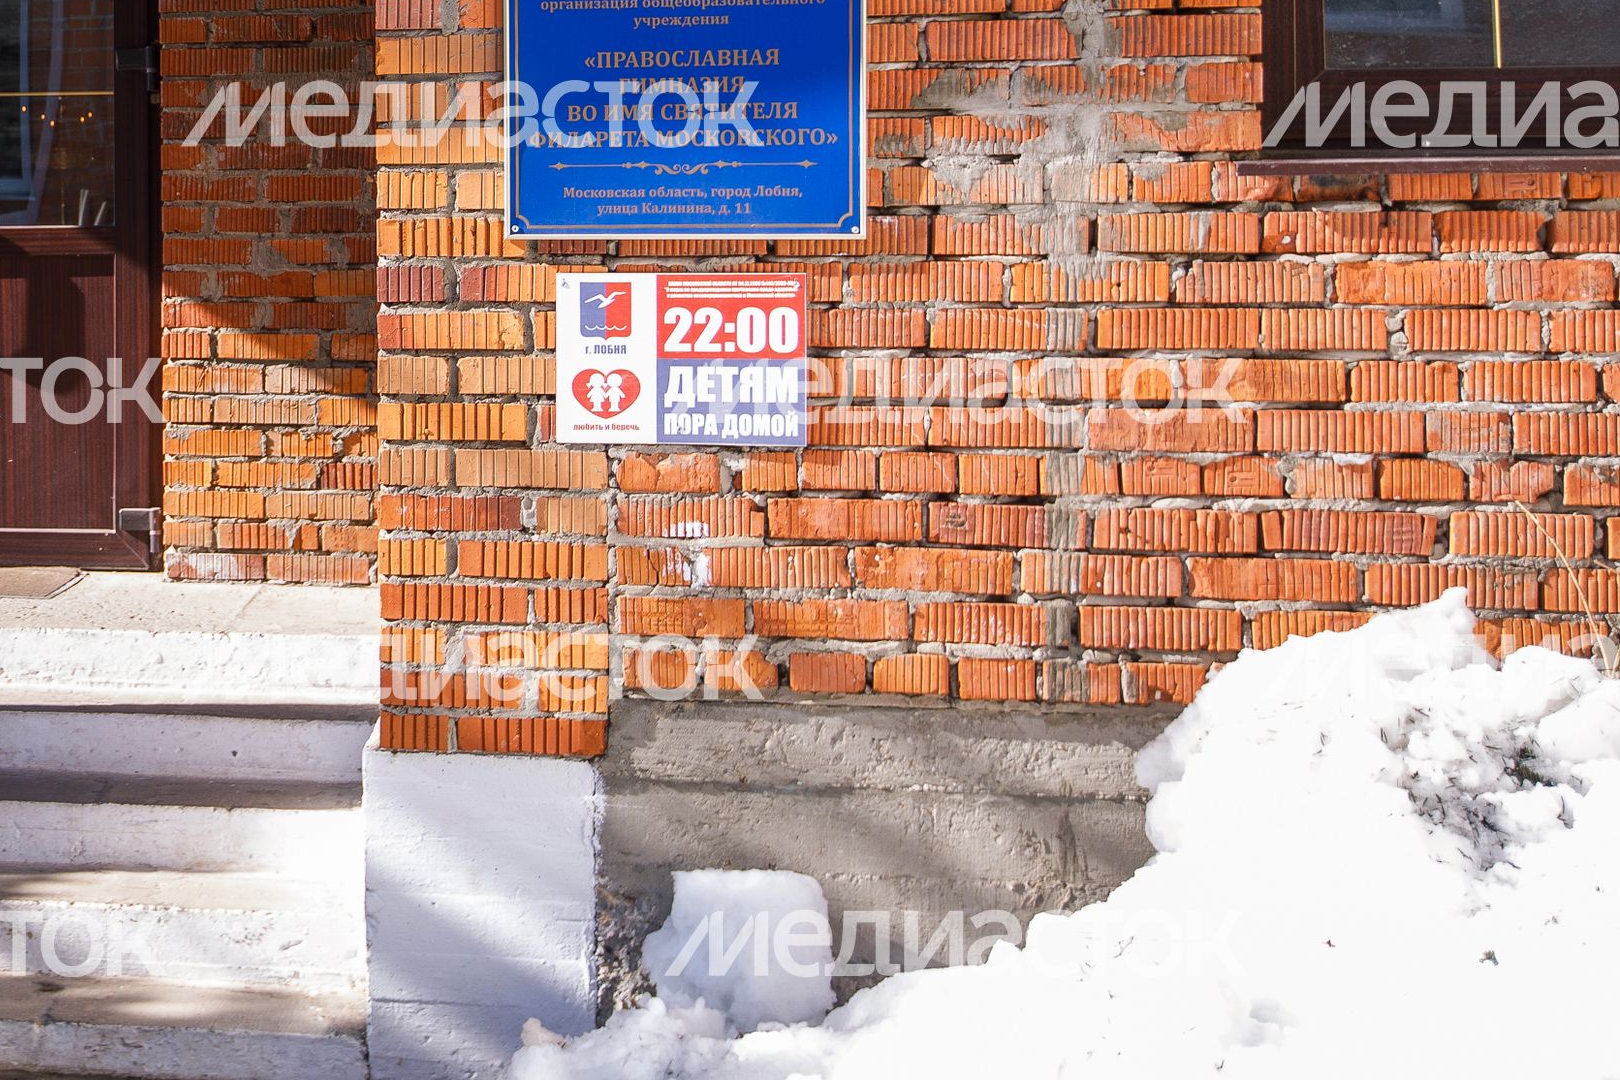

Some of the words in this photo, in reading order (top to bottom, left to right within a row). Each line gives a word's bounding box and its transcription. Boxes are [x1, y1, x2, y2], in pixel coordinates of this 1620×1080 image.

[540, 0, 638, 13] организация
[633, 15, 729, 29] учреждения
[584, 48, 779, 69] «ПРАВОСЛАВНАЯ
[619, 76, 745, 95] ГИМНАЗИЯ
[567, 104, 597, 122] ВО
[604, 103, 654, 121] ИМЯ
[661, 101, 798, 121] СВЯТИТЕЛЯ
[531, 130, 650, 149] ФИЛАРЕТА
[655, 127, 837, 148] МОСКОВСКОГО»
[563, 186, 646, 199] Московская
[649, 186, 708, 200] область,
[711, 187, 751, 200] город
[754, 185, 803, 199] Лобня,
[597, 204, 639, 217] улица
[642, 202, 715, 216] Калинина,
[719, 203, 731, 215] д.
[735, 202, 752, 214] 11
[663, 306, 799, 353] 22:00
[585, 346, 592, 355] г.
[594, 344, 627, 355] ЛОБНЯ
[664, 366, 799, 408] ДЕТЯМ
[573, 423, 603, 431] любить
[611, 423, 640, 432] беречь
[664, 412, 719, 436] ПОРА
[721, 410, 799, 439] ДОМОЙ
